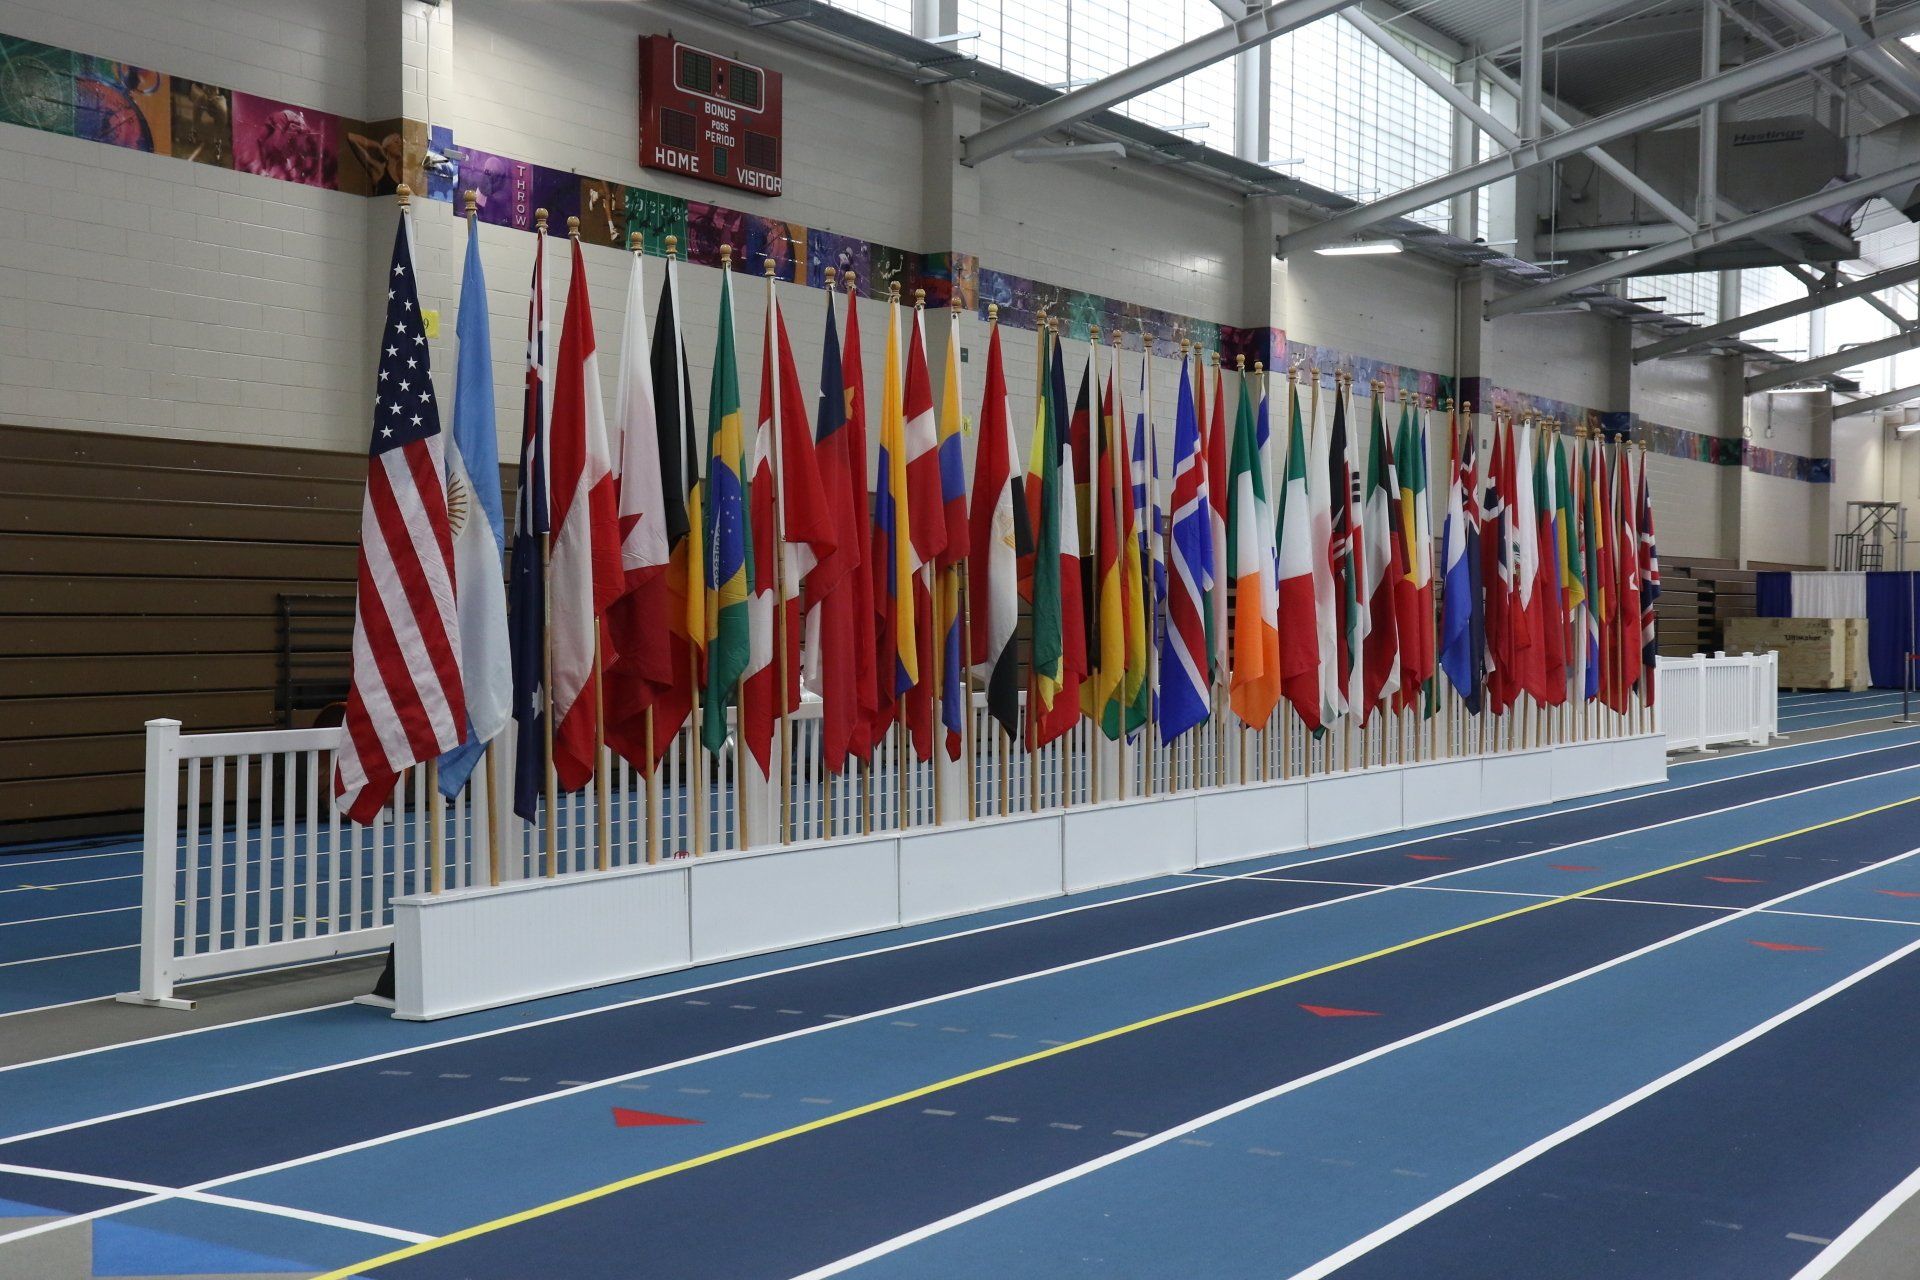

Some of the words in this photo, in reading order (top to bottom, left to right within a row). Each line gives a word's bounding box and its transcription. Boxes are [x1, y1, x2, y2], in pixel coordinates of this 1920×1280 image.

[705, 102, 736, 121] BONUS
[711, 120, 729, 133] POSS
[1734, 129, 1806, 143] Hastings
[705, 130, 735, 147] PERIOD
[655, 147, 699, 173] HOME
[737, 167, 782, 193] VISITOR
[515, 165, 527, 226] THROW
